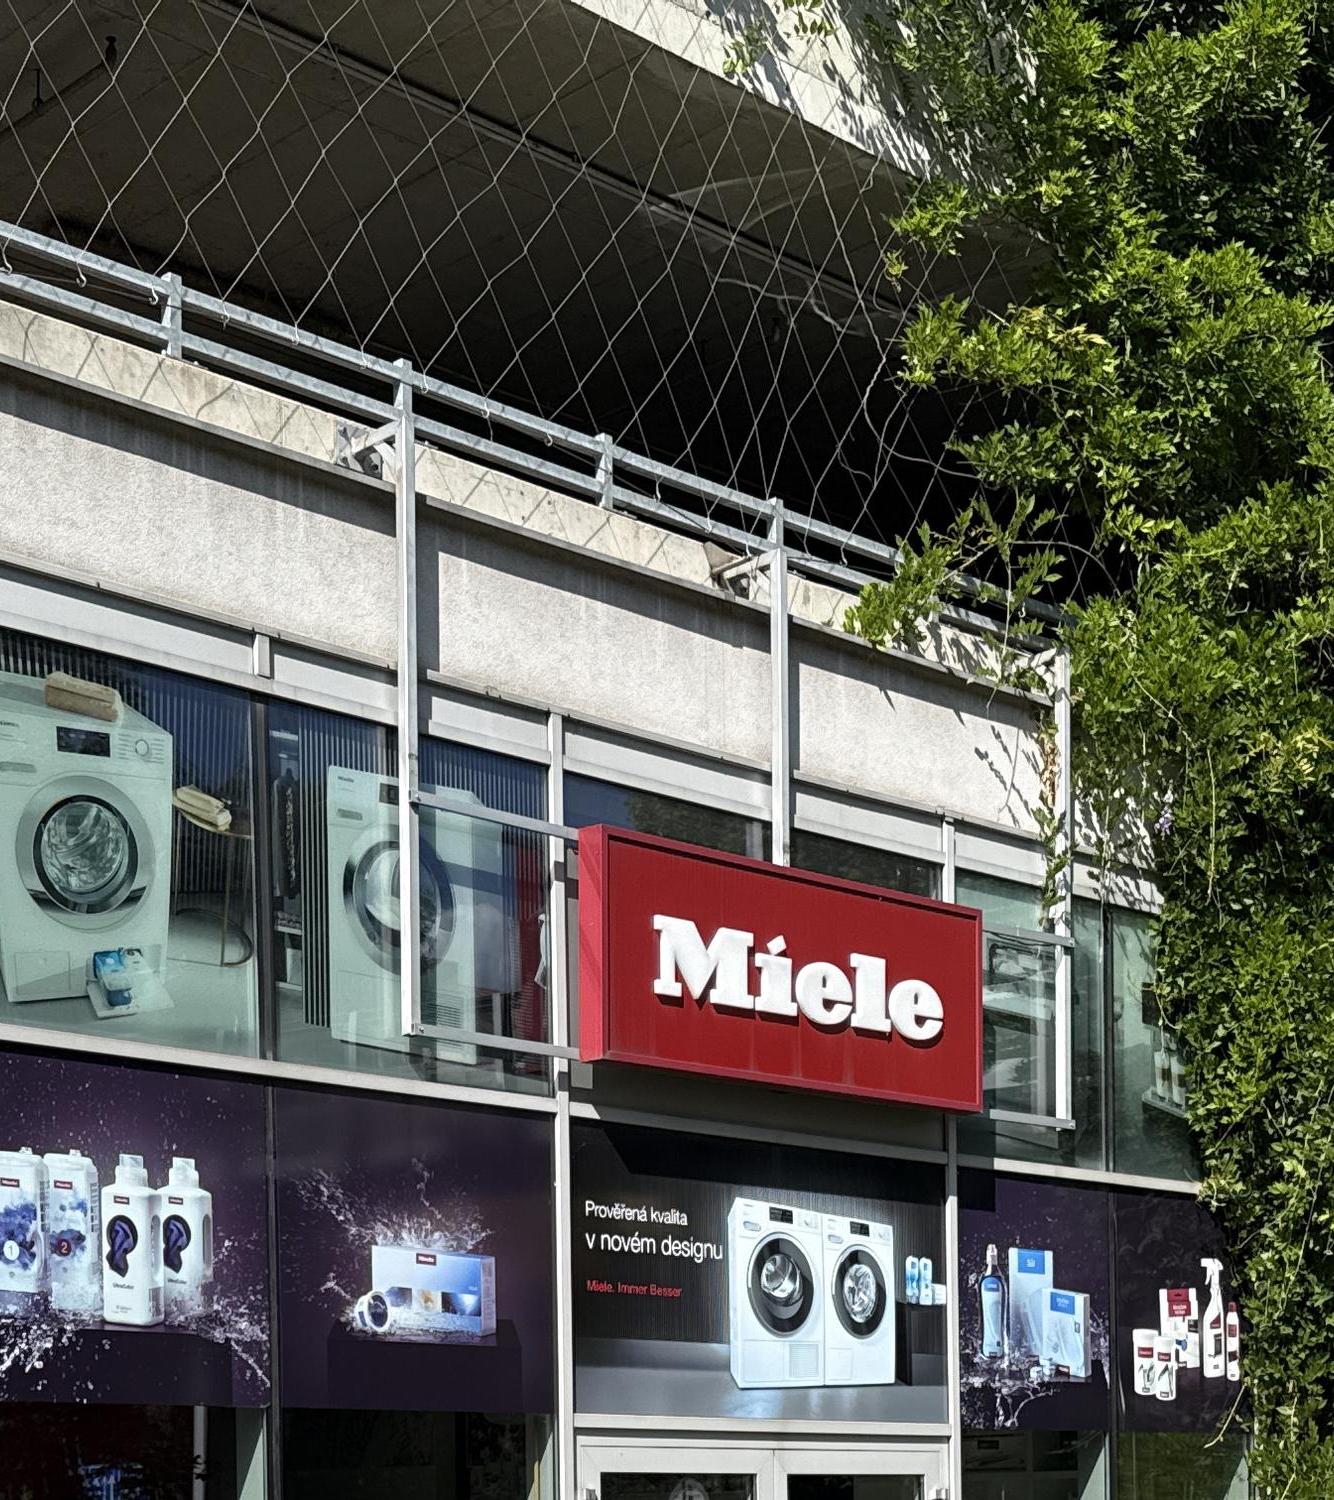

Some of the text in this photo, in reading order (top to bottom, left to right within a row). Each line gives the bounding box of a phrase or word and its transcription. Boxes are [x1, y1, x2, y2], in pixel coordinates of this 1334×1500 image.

[653, 914, 944, 1041] Miele
[585, 1200, 688, 1226] Prověřená kvalita
[61, 1244, 68, 1253] 2
[585, 1231, 723, 1263] v novém designu
[618, 1281, 648, 1295] Immer
[650, 1284, 683, 1298] Besser
